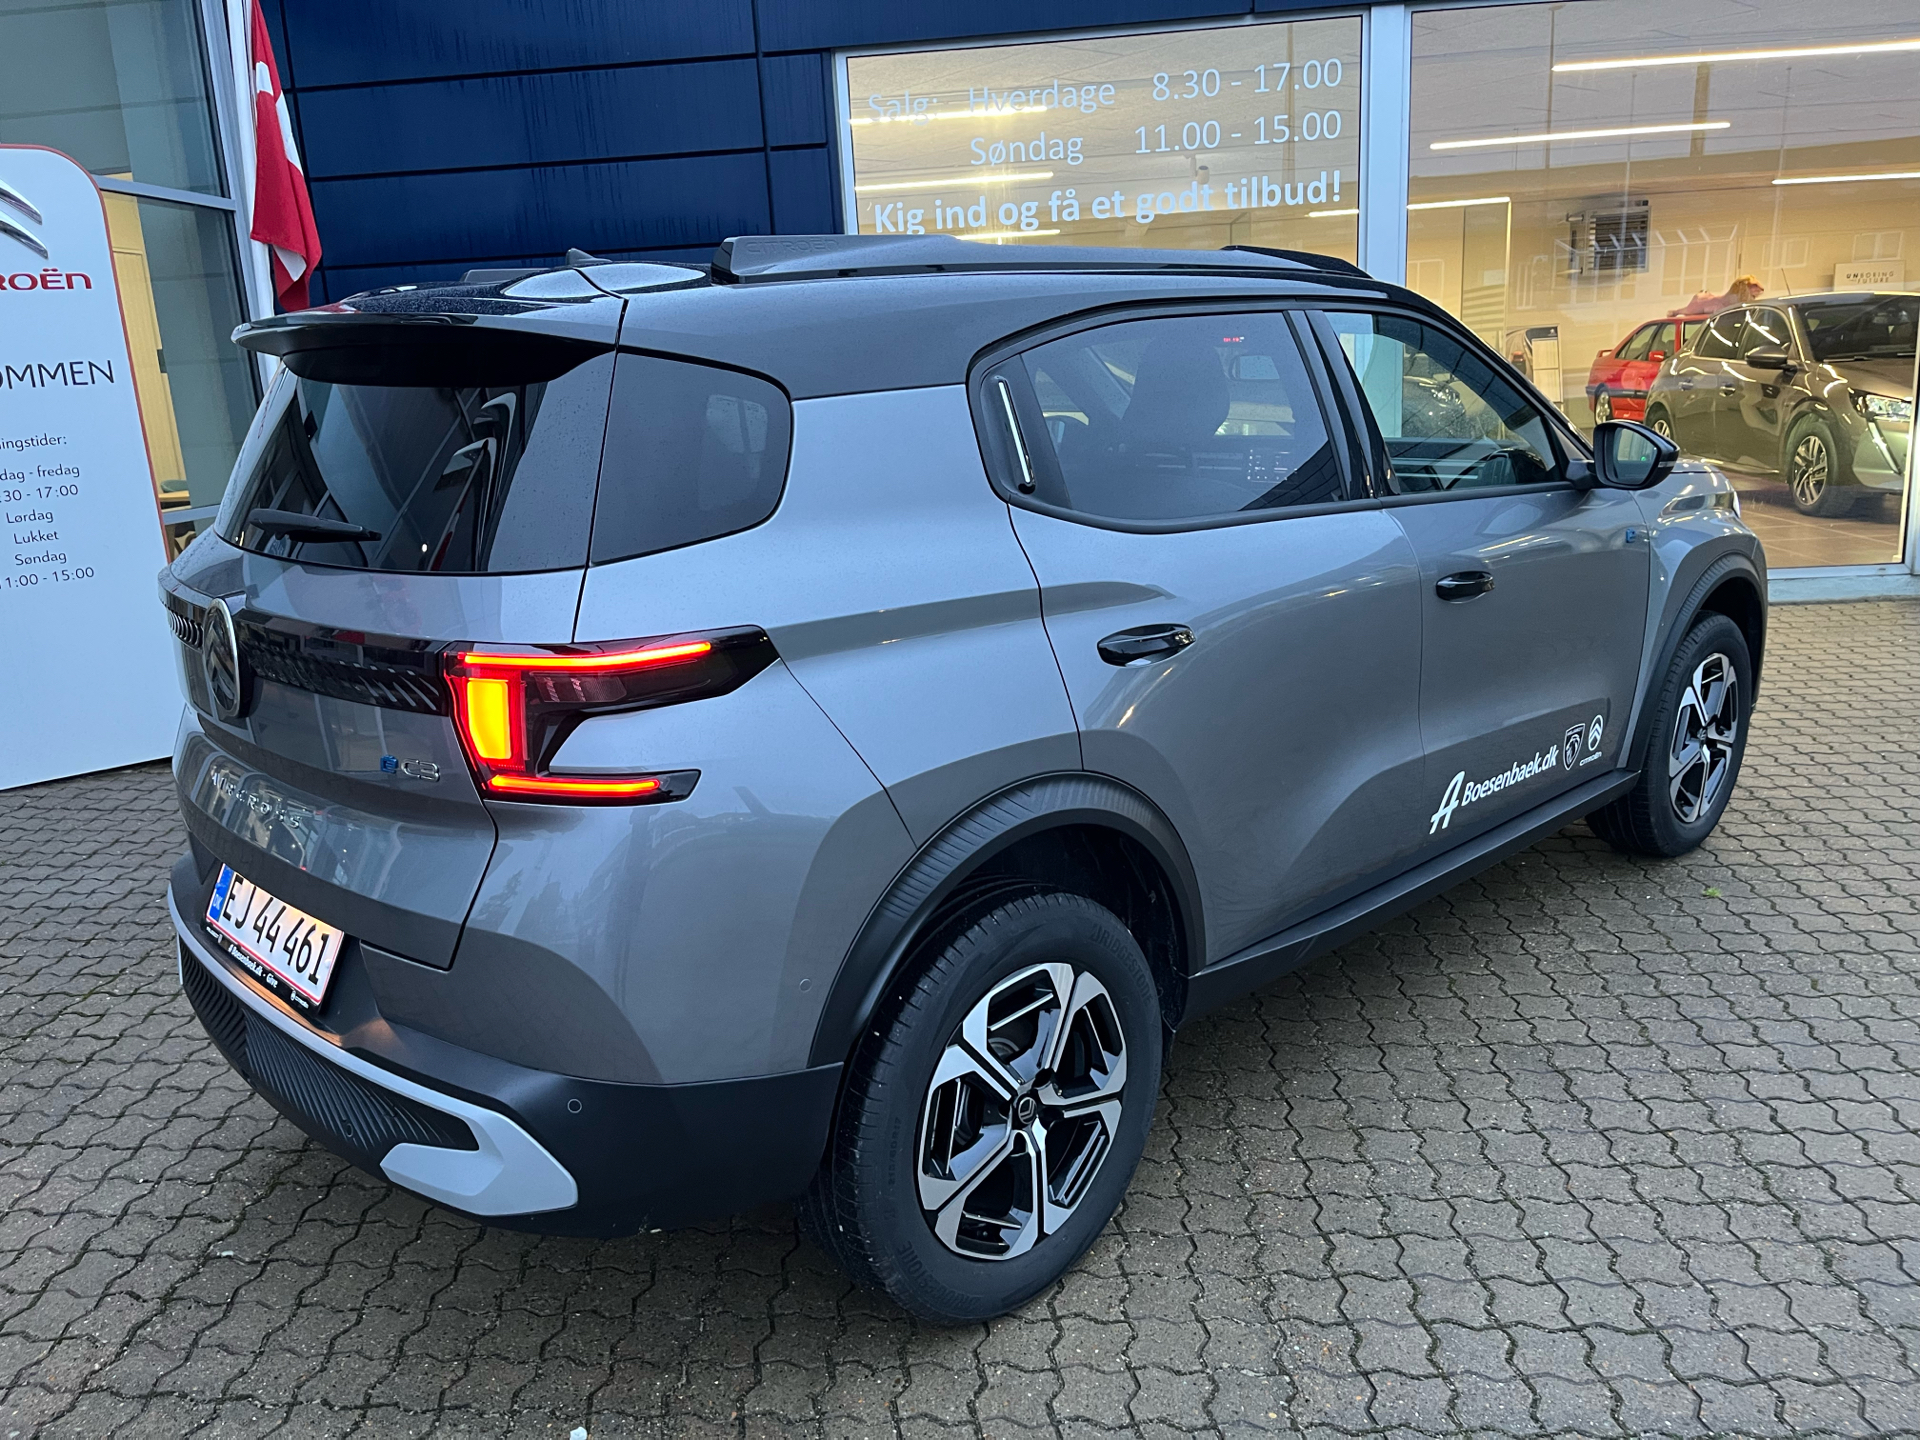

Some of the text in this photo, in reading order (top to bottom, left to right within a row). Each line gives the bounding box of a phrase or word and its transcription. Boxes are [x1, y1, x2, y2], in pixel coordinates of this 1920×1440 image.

[868, 90, 938, 126] Salg:
[968, 79, 1116, 114] Hverdage
[1152, 68, 1221, 101] 8.30
[1253, 58, 1343, 93] 17.00
[970, 131, 1085, 167] Søndag
[1134, 120, 1221, 154] 11.00
[1253, 110, 1342, 145] 15.00
[874, 169, 1341, 235] Kig ind og få et godt tilbud!
[0, 360, 115, 390] MMEN
[0, 432, 67, 452] ingstider:
[37, 463, 80, 478] fredag
[36, 484, 79, 499] 17:00
[6, 508, 54, 524] Lørdag
[13, 529, 60, 545] Lukket
[14, 549, 67, 566] Søndag
[0, 573, 39, 589] 1:00
[52, 566, 95, 582] 15:00
[401, 758, 441, 782] C3
[1461, 744, 1560, 807] Boesenbaek.dk
[222, 873, 330, 986] EJ 44 461
